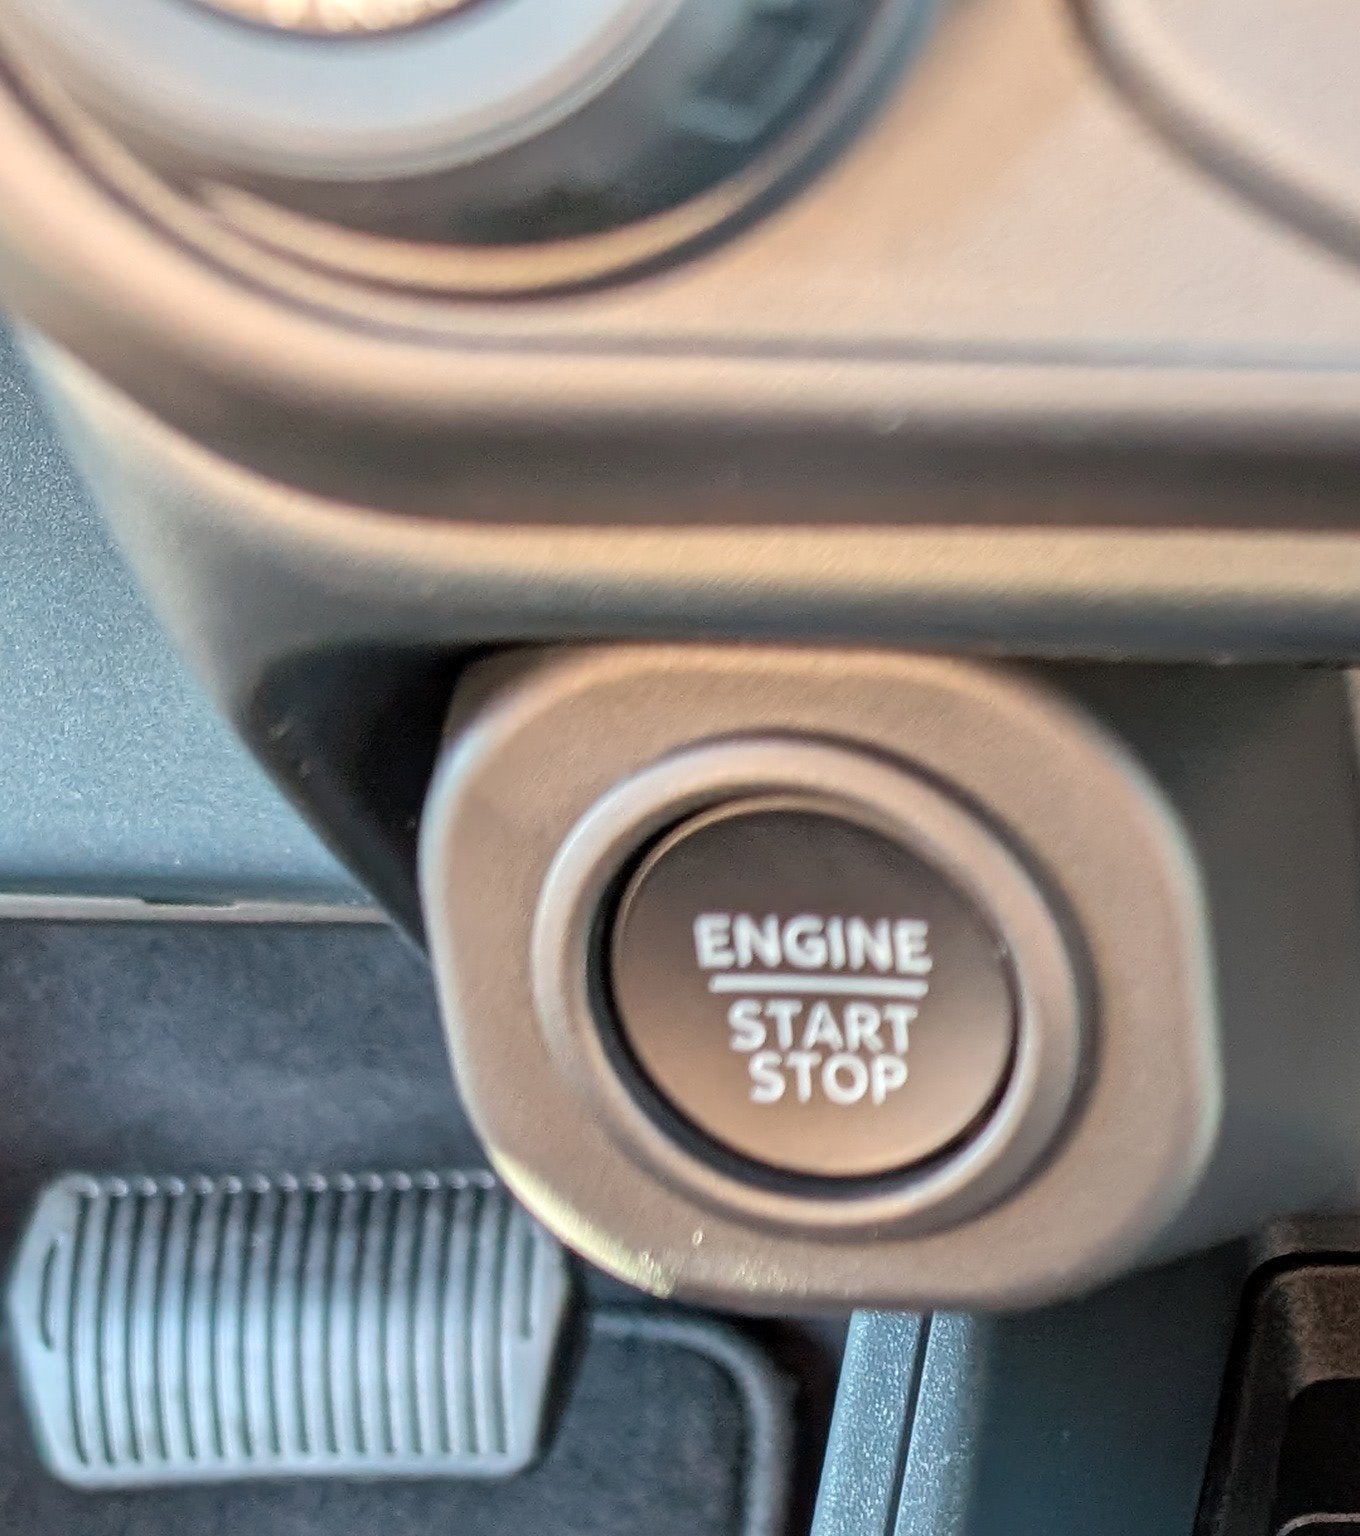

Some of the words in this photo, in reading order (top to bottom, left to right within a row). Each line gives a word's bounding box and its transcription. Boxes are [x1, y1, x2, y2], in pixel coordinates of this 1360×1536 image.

[694, 913, 933, 975] ENGINE
[728, 1000, 918, 1053] START
[750, 1051, 908, 1104] STOP
